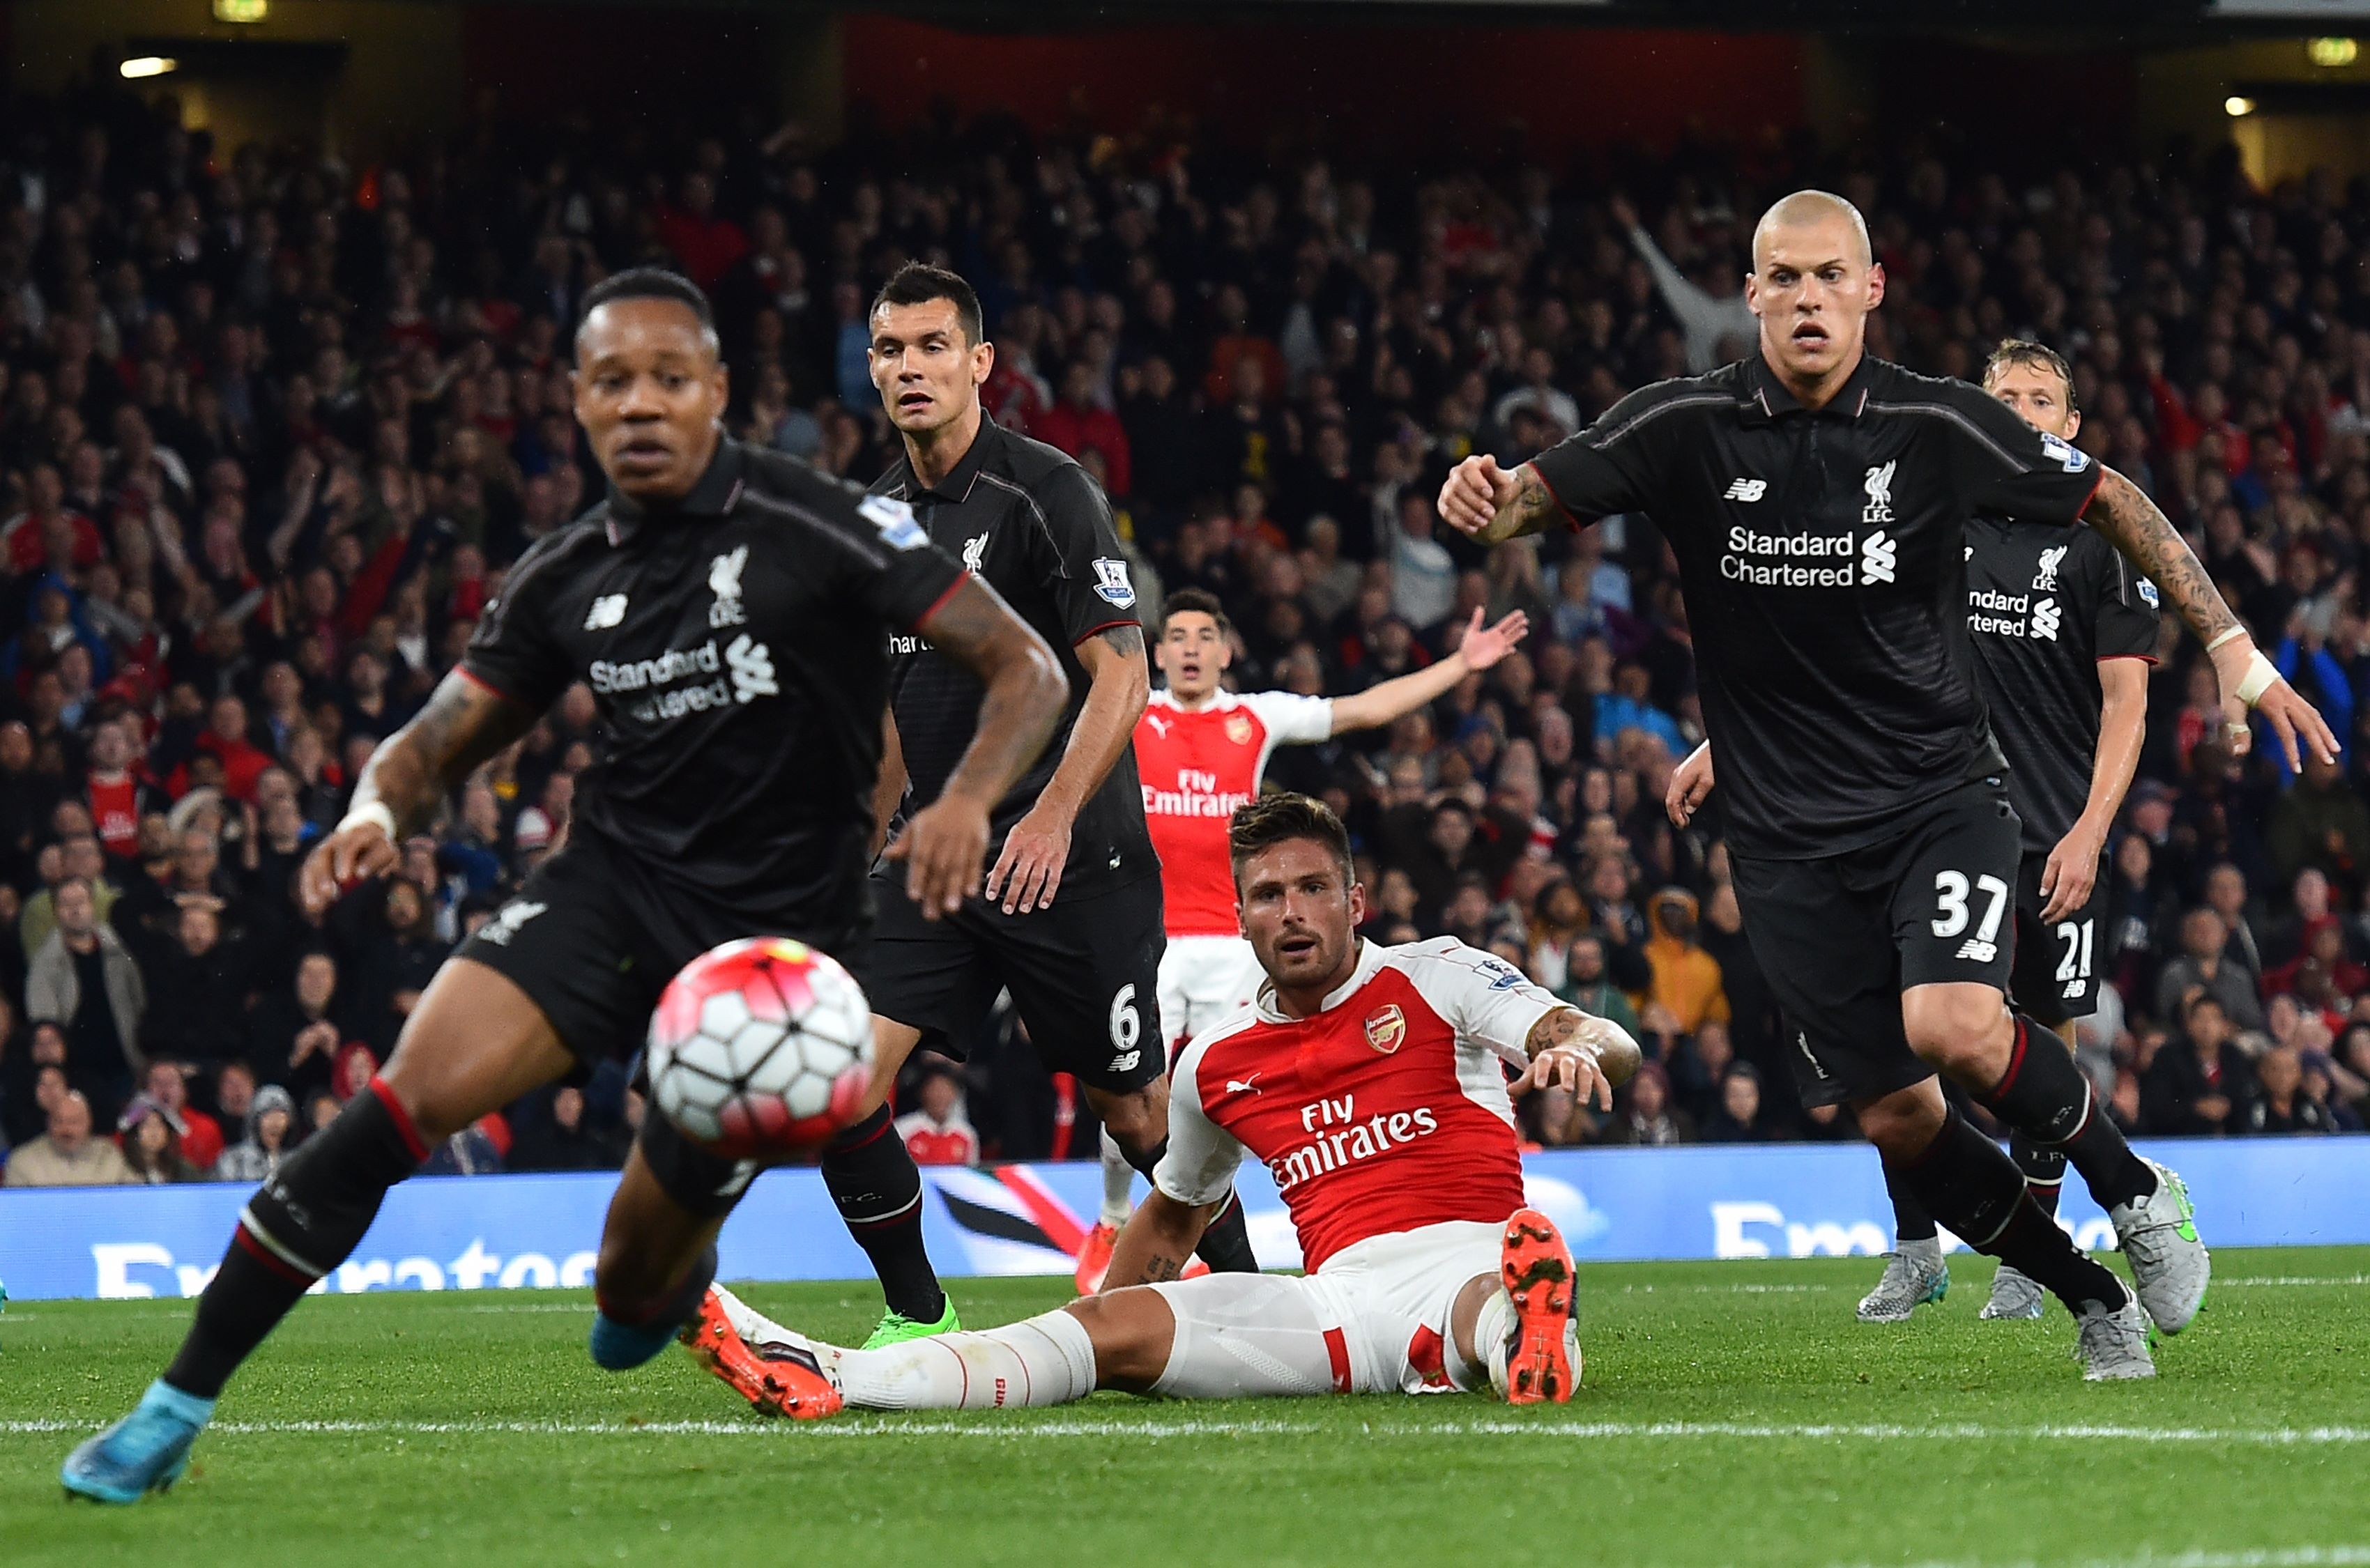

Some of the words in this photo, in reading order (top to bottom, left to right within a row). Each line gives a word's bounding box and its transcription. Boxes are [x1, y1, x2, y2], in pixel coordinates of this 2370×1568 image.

[1728, 525, 1853, 556] Standard
[1720, 555, 1853, 586] Chartered
[1968, 589, 2029, 613] ndard
[1966, 613, 2026, 637] rtered
[889, 632, 935, 654] hart
[1178, 769, 1216, 793] Fly
[1930, 870, 2008, 942] 37
[2055, 918, 2094, 981] 21
[1109, 983, 1140, 1051] 6
[1301, 1093, 1353, 1132] Fly
